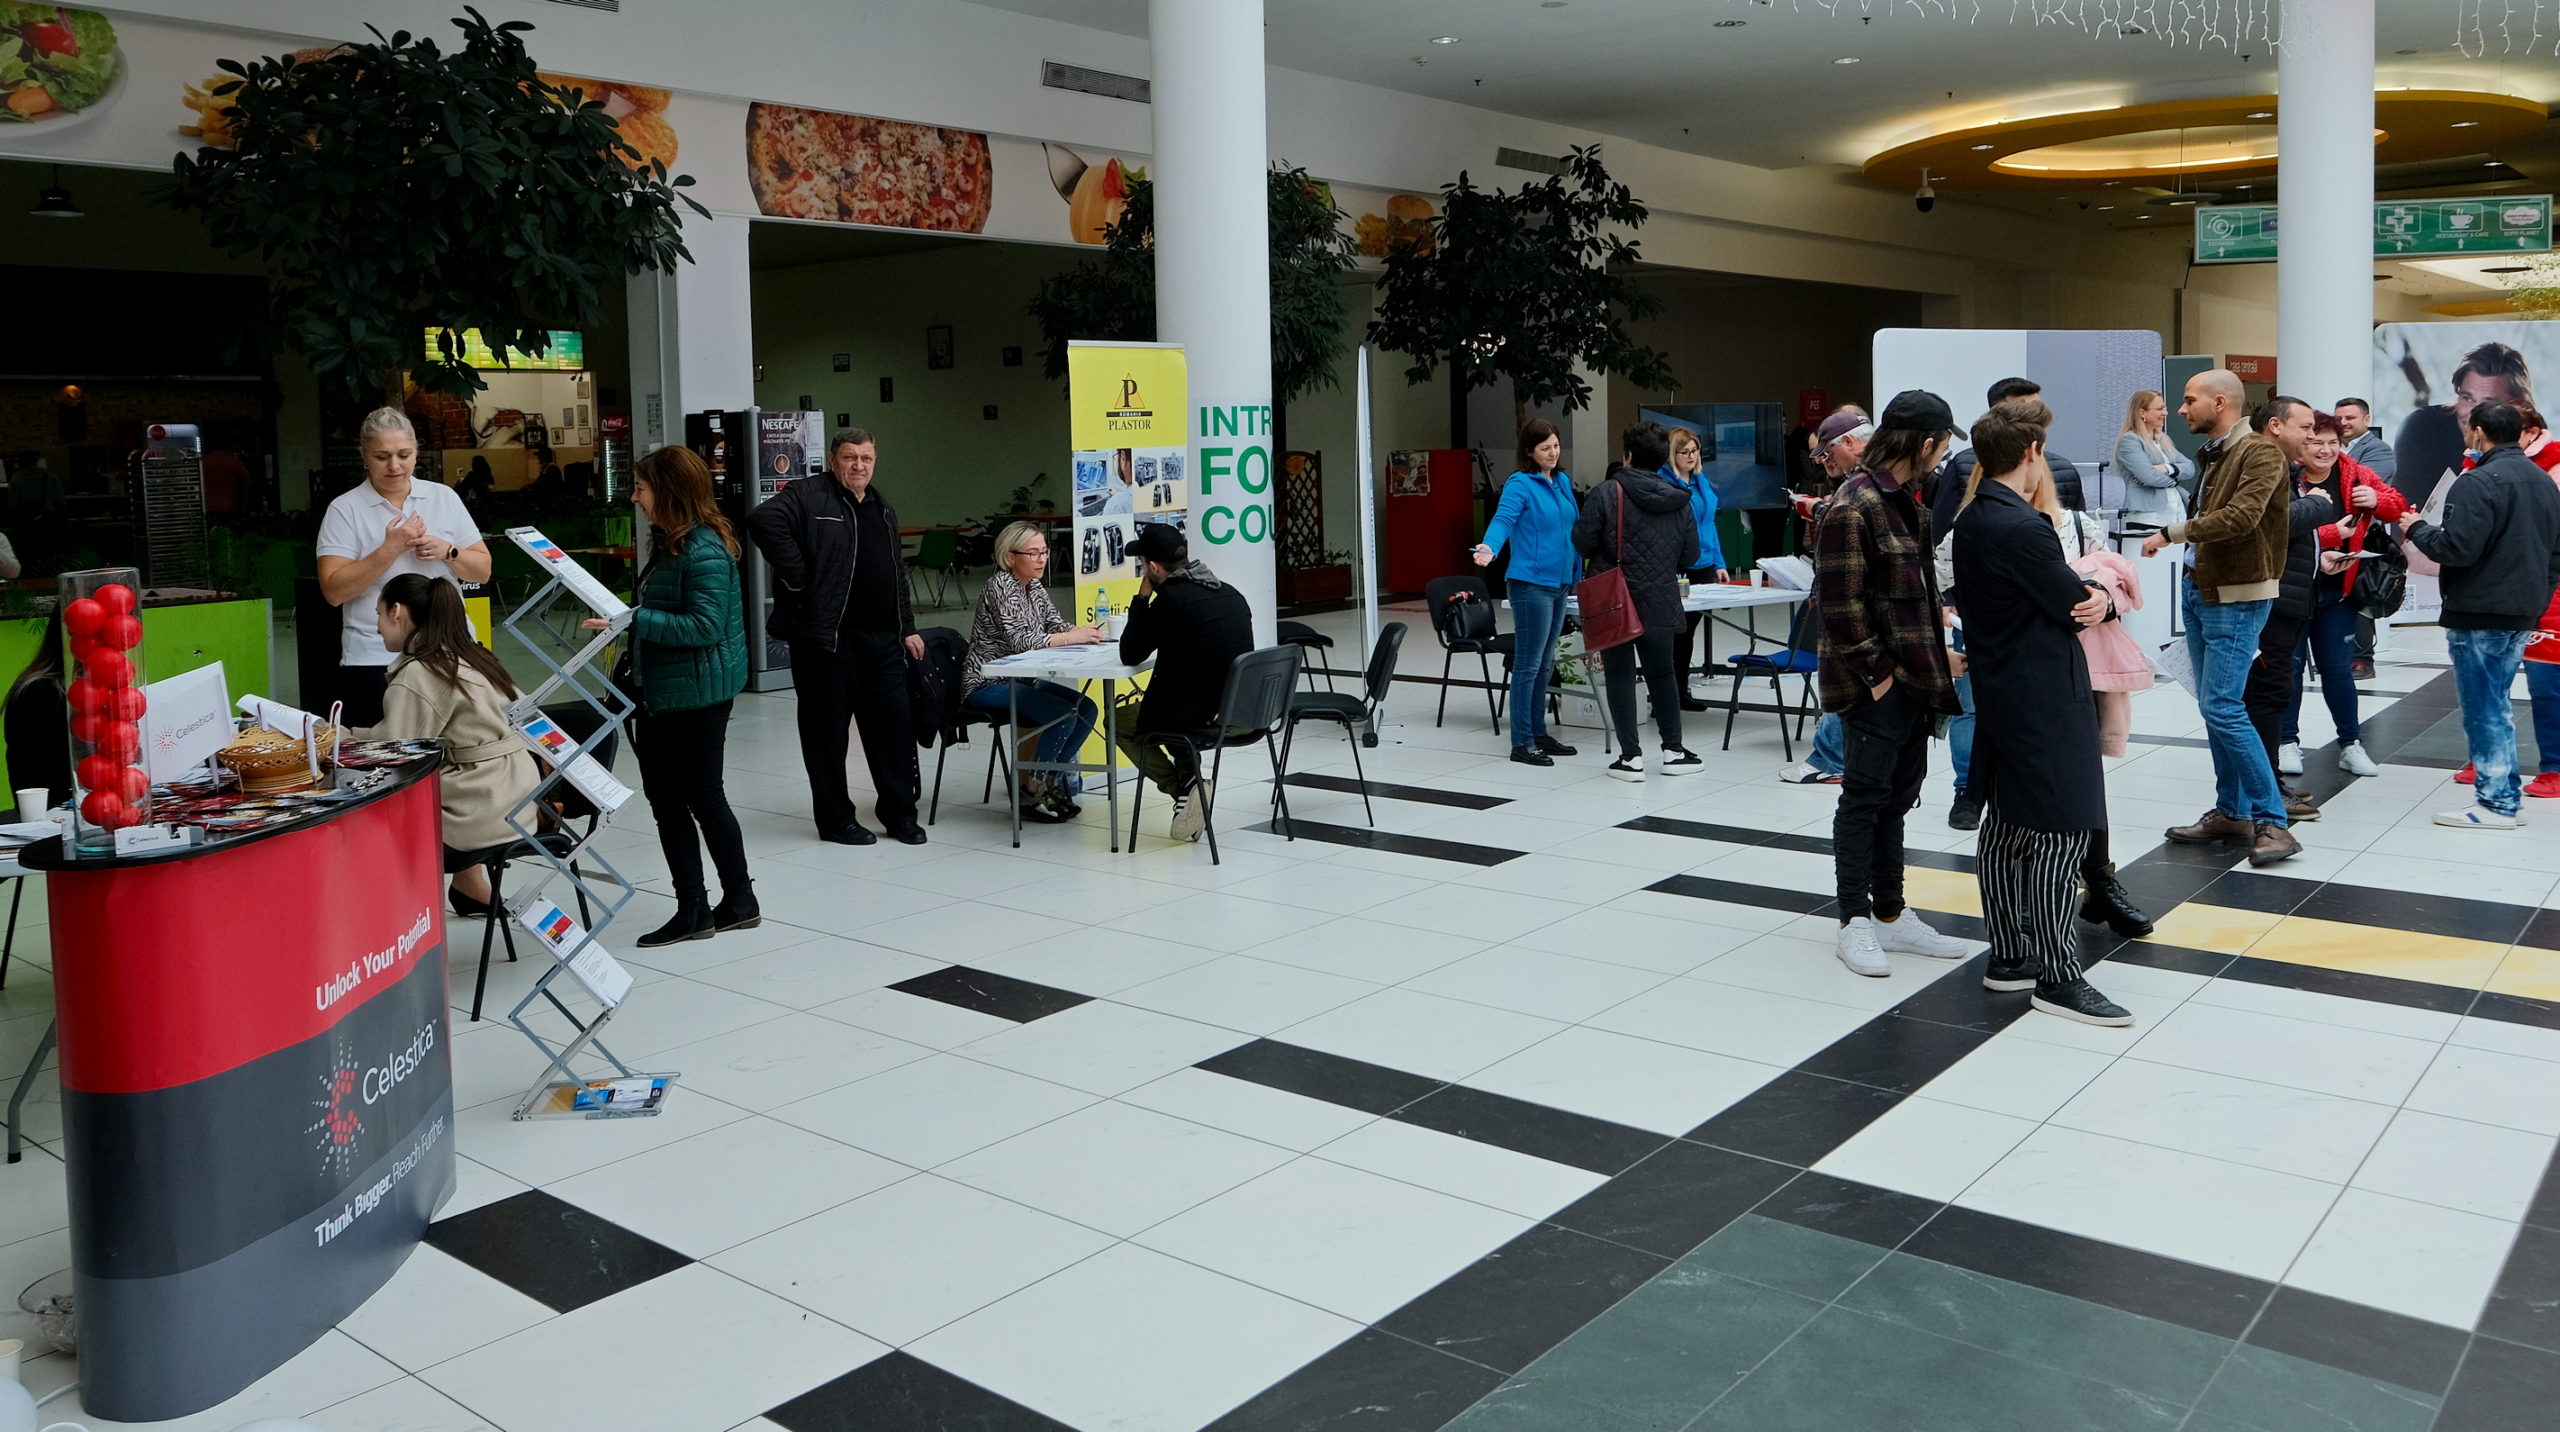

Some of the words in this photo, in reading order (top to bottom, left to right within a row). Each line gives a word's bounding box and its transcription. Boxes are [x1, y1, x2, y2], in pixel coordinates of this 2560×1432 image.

[1108, 419, 1152, 431] PLASTOR
[1200, 445, 1274, 495] FO
[175, 711, 215, 740] Celestica
[316, 961, 362, 1011] Unlock
[362, 946, 396, 979] Your
[397, 907, 431, 960] Potential
[314, 1204, 354, 1248] Think
[354, 1173, 393, 1216] Bigger.
[392, 1143, 421, 1185] Reach
